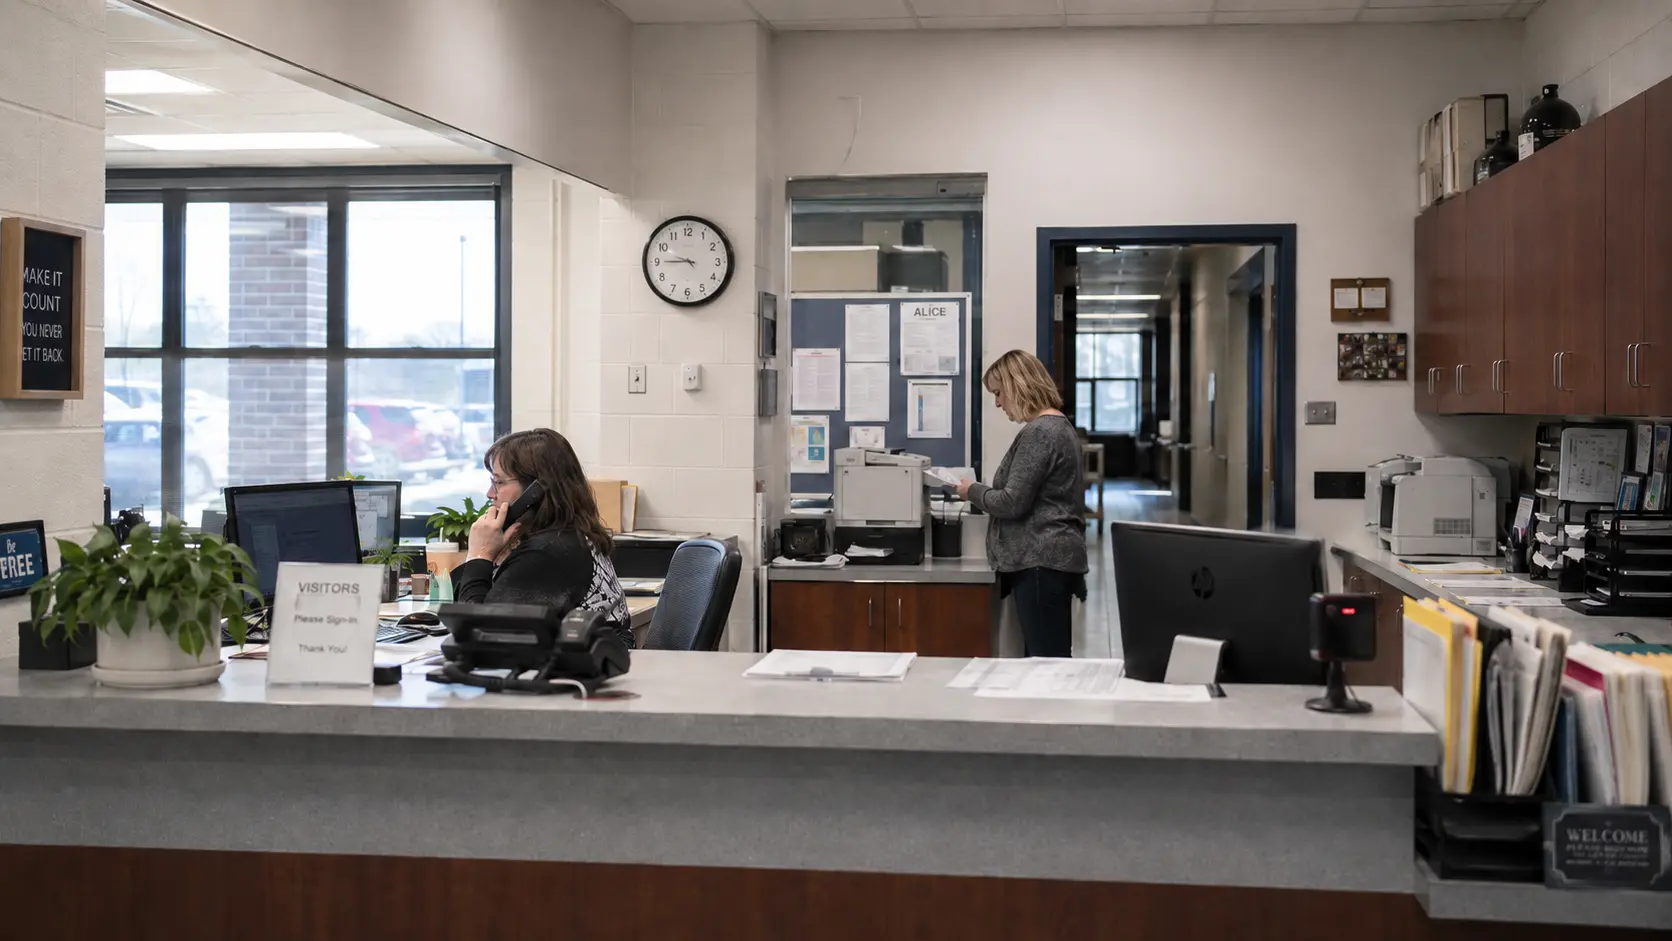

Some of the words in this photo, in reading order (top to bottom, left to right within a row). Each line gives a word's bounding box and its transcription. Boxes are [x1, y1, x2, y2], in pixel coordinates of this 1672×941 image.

[670, 231, 678, 241] 11
[683, 227, 693, 237] 12
[701, 231, 705, 240] 1
[658, 242, 668, 252] 10
[709, 242, 716, 252] 2
[654, 257, 660, 267] 9
[714, 257, 721, 267] 3
[24, 267, 50, 286] MAKE
[53, 271, 63, 287] IT
[659, 272, 665, 282] 8
[710, 272, 716, 281] 4
[671, 283, 676, 293] 7
[684, 287, 691, 297] 6
[700, 283, 705, 293] 5
[23, 292, 61, 312] COUNT
[22, 322, 38, 337] YOU
[39, 323, 63, 339] NEVER
[22, 347, 32, 361] ET
[33, 348, 41, 361] IT
[298, 582, 360, 593] VISITORS
[294, 614, 323, 624] Please
[299, 644, 324, 653] Thank
[1566, 828, 1650, 844] WELCOME
